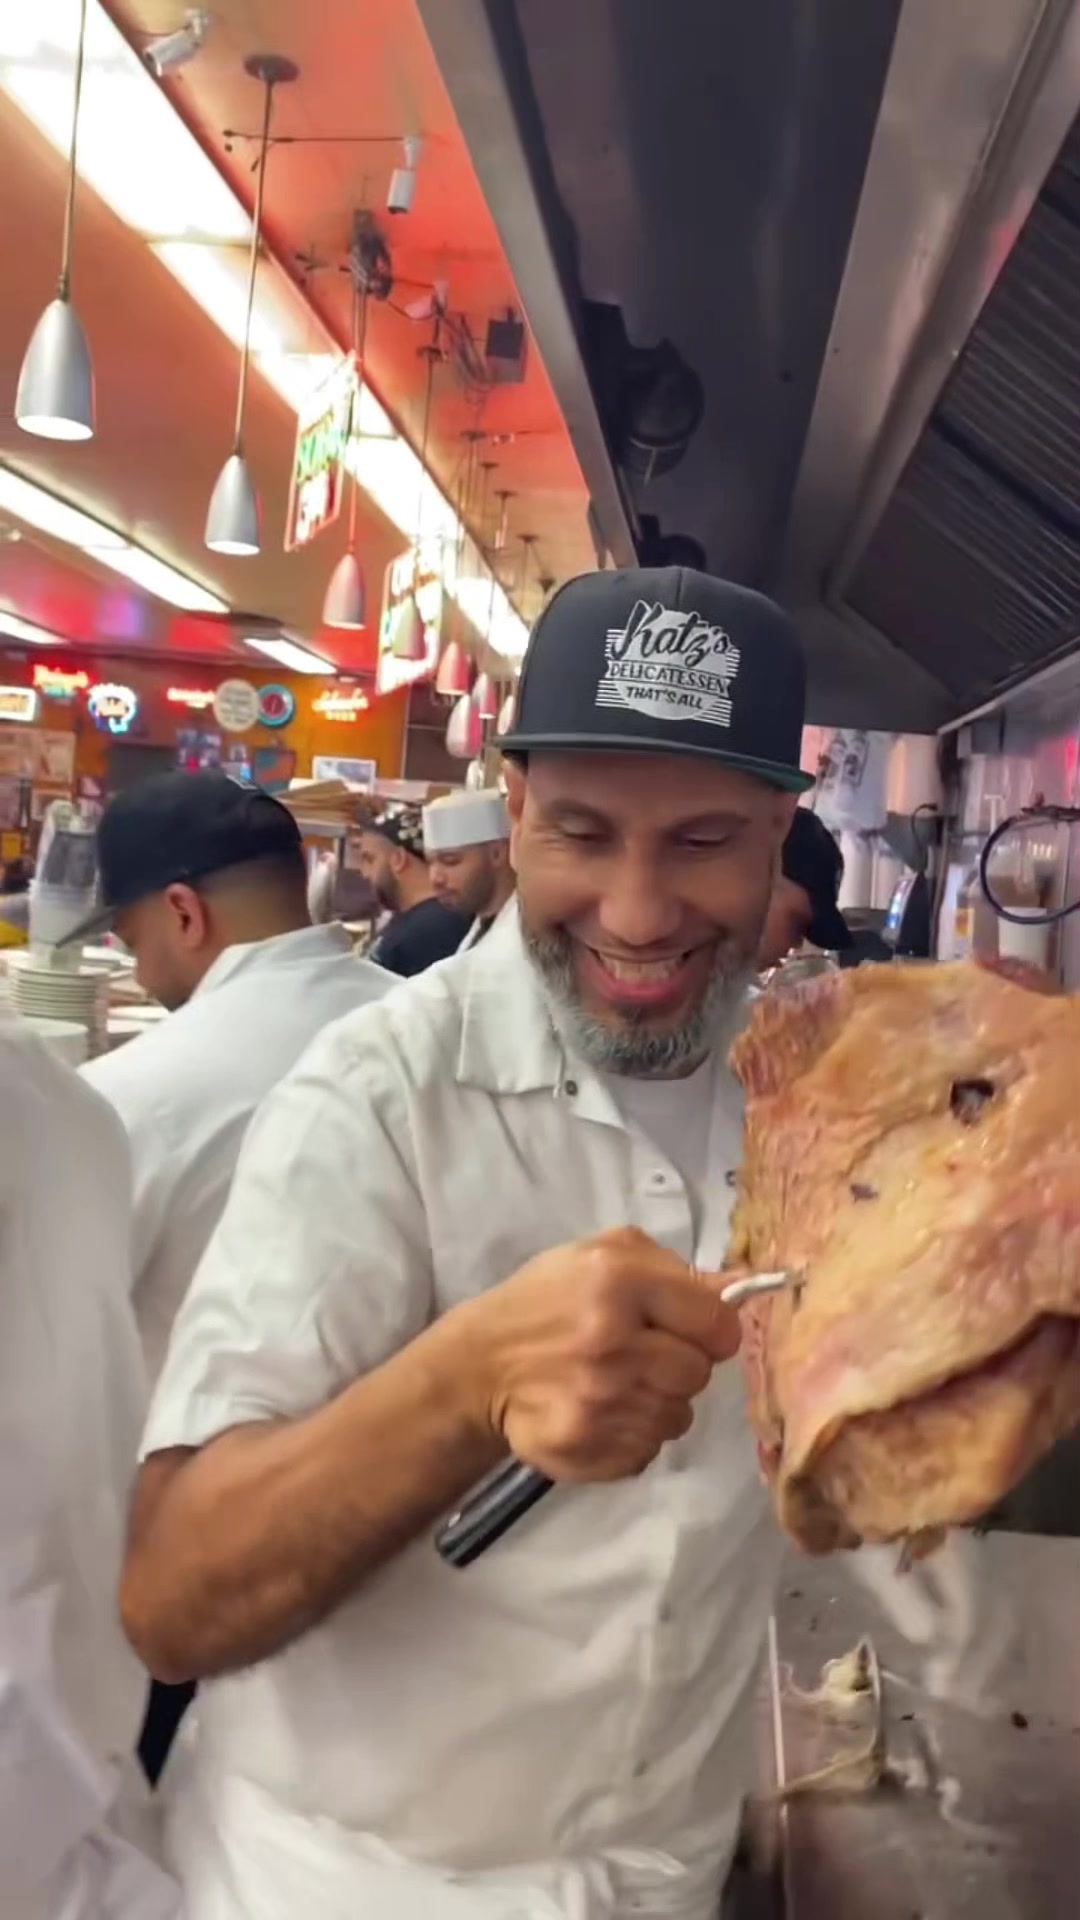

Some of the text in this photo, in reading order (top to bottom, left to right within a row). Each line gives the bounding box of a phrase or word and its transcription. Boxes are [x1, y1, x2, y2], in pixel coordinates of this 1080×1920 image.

[611, 600, 729, 667] Katz's
[610, 663, 728, 694] DELICATESSEN
[626, 686, 703, 709] THAT'S ALL
